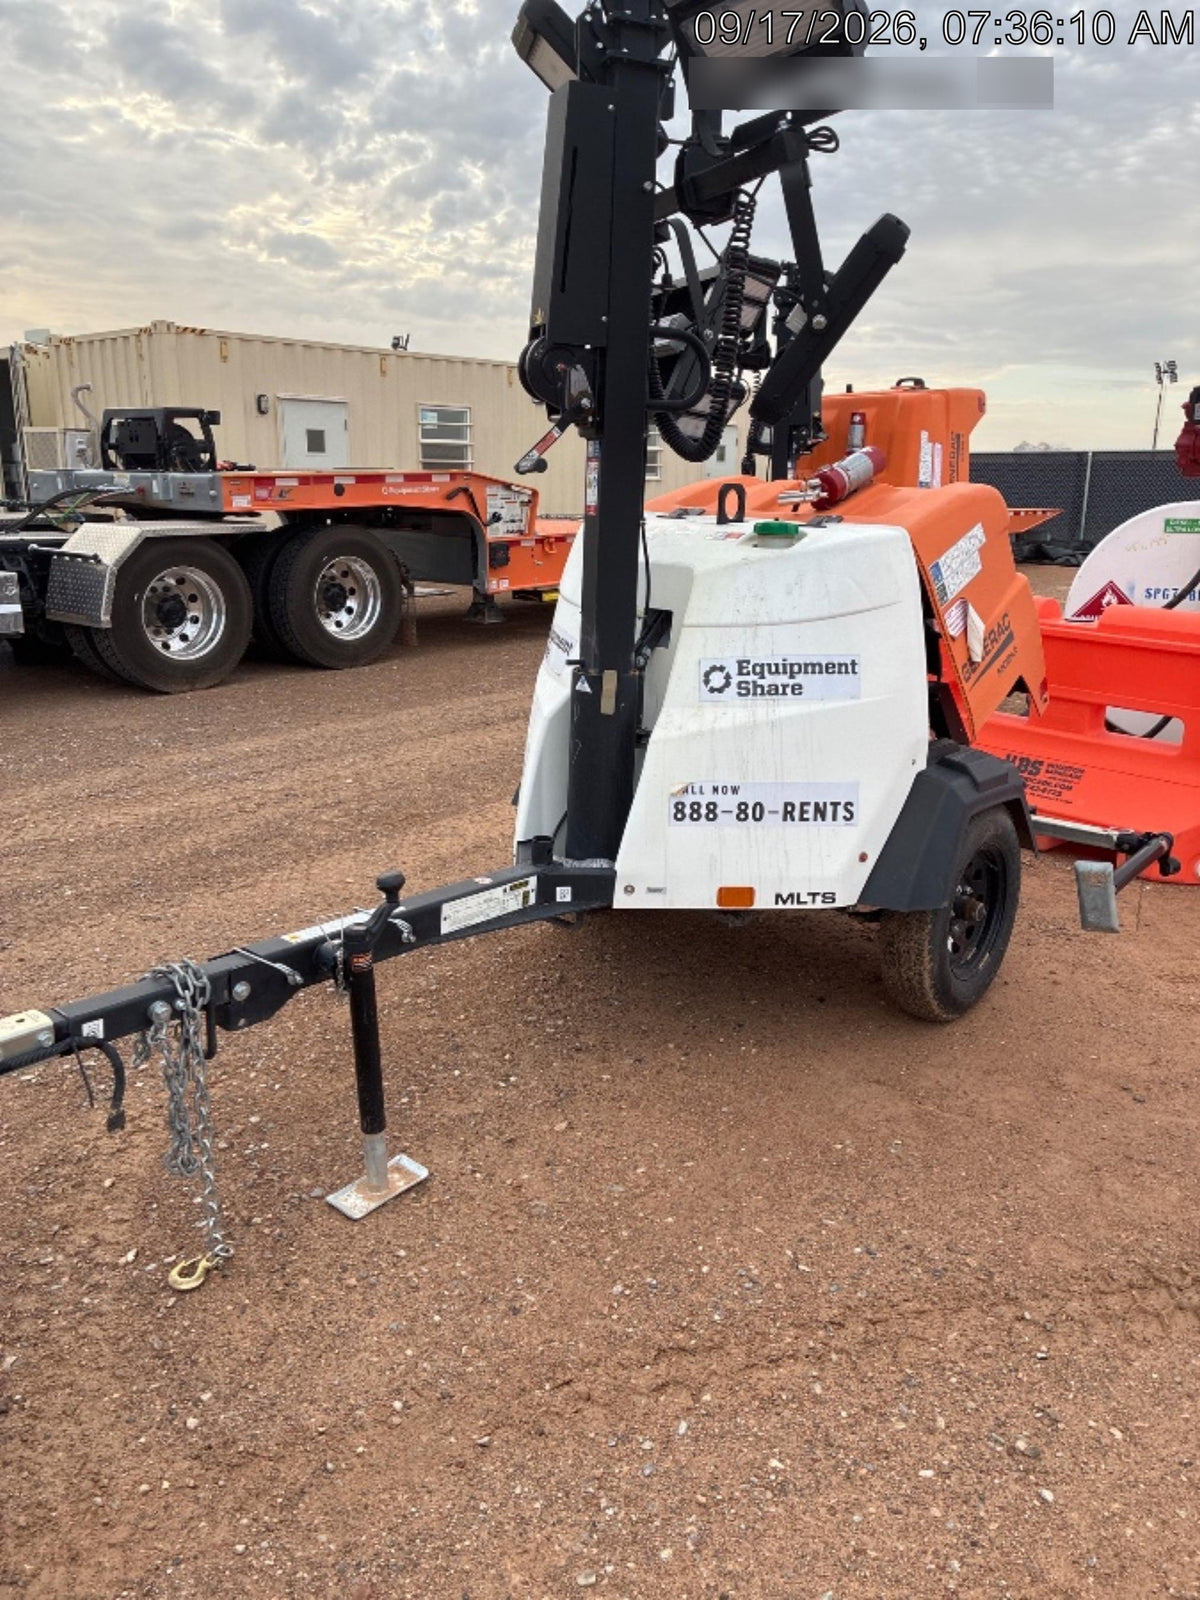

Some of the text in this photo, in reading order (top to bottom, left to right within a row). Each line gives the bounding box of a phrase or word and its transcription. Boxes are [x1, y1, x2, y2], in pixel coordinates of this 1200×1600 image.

[736, 658, 858, 680] Equipment
[736, 680, 803, 698] Share
[682, 785, 740, 795] ALL NOW
[673, 801, 854, 822] 888-80-RENTS
[774, 892, 836, 905] MLTS
